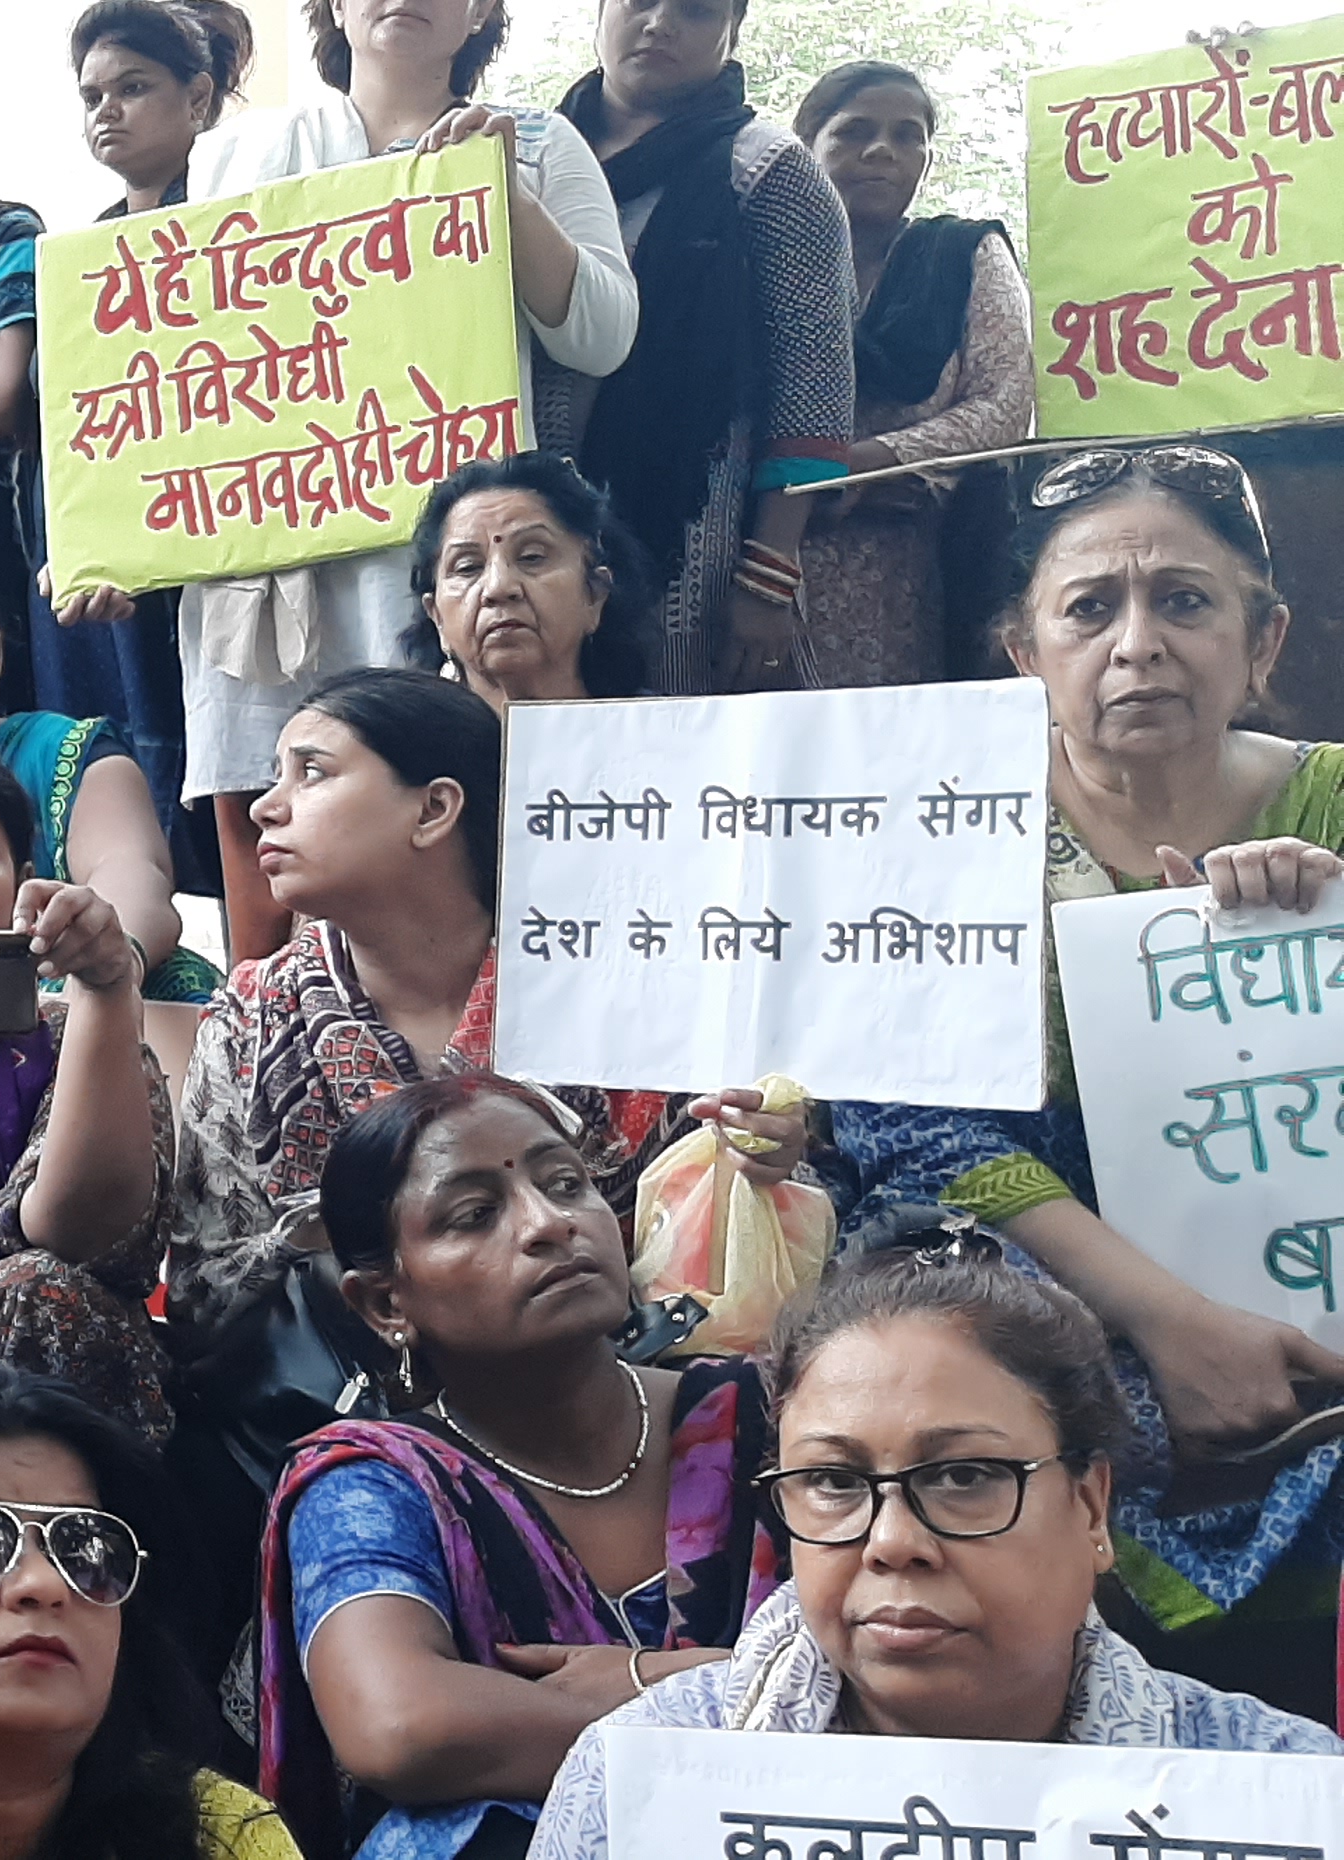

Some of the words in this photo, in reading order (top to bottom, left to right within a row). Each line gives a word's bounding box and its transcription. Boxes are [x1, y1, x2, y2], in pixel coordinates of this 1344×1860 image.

[81, 235, 153, 334] ये
[151, 219, 200, 327] है
[201, 196, 432, 318] हिन्दुत्व
[432, 187, 492, 264] का
[1187, 154, 1294, 260] को
[69, 350, 165, 460] स्त्री
[165, 320, 349, 436] विरोधी
[1046, 288, 1181, 401] शह
[141, 388, 403, 536] मानवद्रोही
[525, 787, 673, 842] बीजेपी
[698, 785, 887, 839] विधायक
[918, 776, 1032, 839] सेंगर
[520, 904, 600, 962] देश
[628, 908, 673, 960] के
[698, 906, 792, 962] लिये
[821, 906, 1029, 967] अभिशाप
